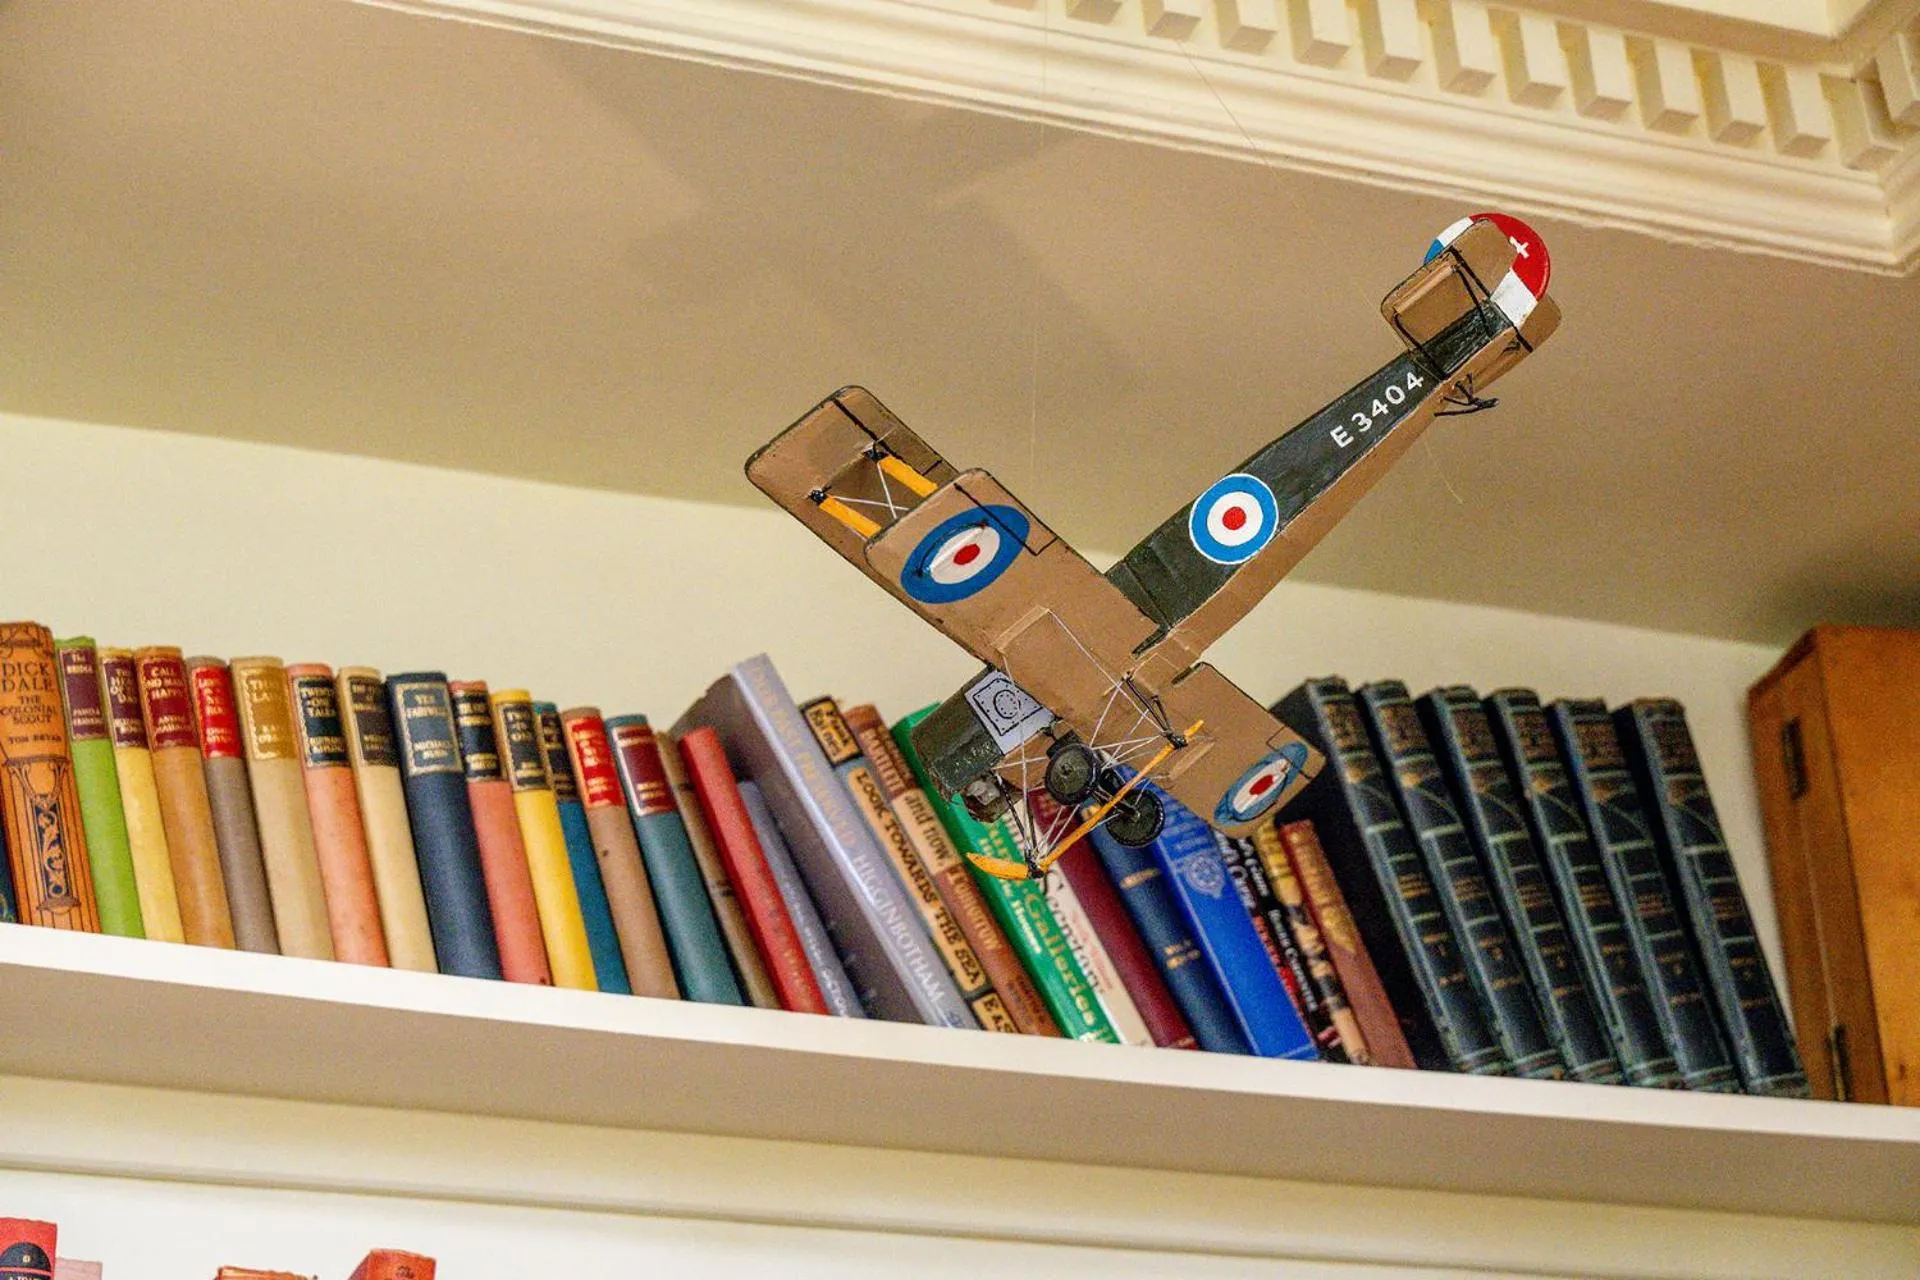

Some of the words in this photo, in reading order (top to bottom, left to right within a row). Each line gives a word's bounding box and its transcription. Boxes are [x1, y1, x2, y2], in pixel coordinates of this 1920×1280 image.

[2, 661, 49, 677] DICK
[2, 677, 54, 692] DALE
[18, 695, 41, 705] THE
[0, 704, 56, 716] COLONIAL
[13, 715, 52, 725] SCOUT
[904, 794, 935, 828] and
[855, 771, 890, 820] LOOK
[883, 817, 937, 904] TOWARDS
[934, 906, 962, 946] THE
[955, 947, 981, 985] SEA
[853, 853, 945, 1004] HIGGINBOTHAM
[1024, 892, 1097, 1027] Galleries
